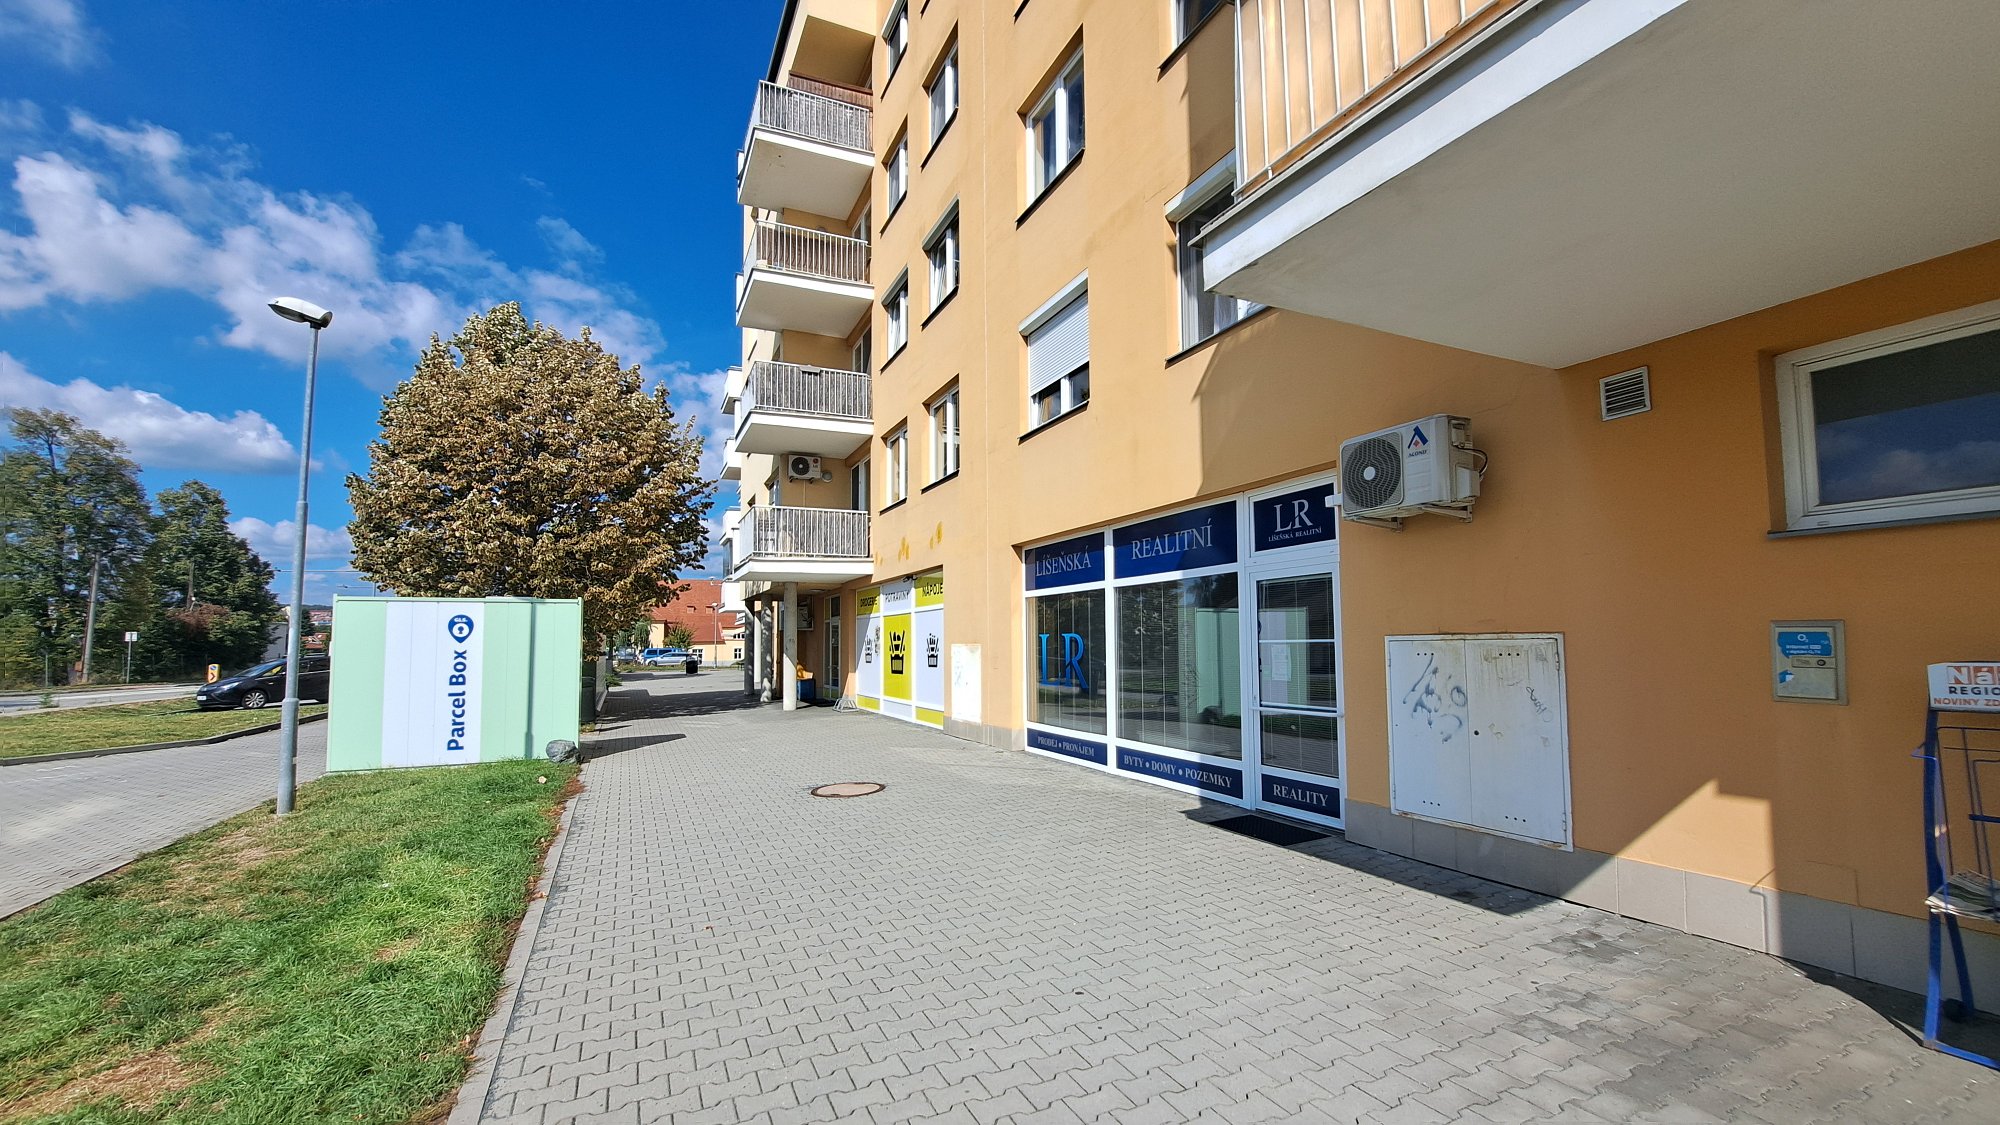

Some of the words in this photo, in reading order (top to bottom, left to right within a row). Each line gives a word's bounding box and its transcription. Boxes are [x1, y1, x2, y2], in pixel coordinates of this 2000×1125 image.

[1273, 499, 1313, 533] LR
[1035, 544, 1092, 577] LÍŠEŇSKÁ
[1131, 518, 1213, 560] REALITNÍ
[922, 582, 944, 598] NÁPOJE
[448, 649, 467, 686] Box
[1038, 632, 1090, 690] LR
[1947, 666, 2000, 685] Ná
[1933, 697, 1979, 705] NOVINY
[446, 691, 466, 751] Parcel
[1037, 735, 1058, 749] PRODEJ
[1062, 740, 1095, 757] PRONÁJEM
[1123, 754, 1144, 768] BYTY
[1151, 760, 1177, 776] DOMY
[1185, 767, 1233, 788] POZEMKY
[1273, 784, 1329, 807] REALITY
